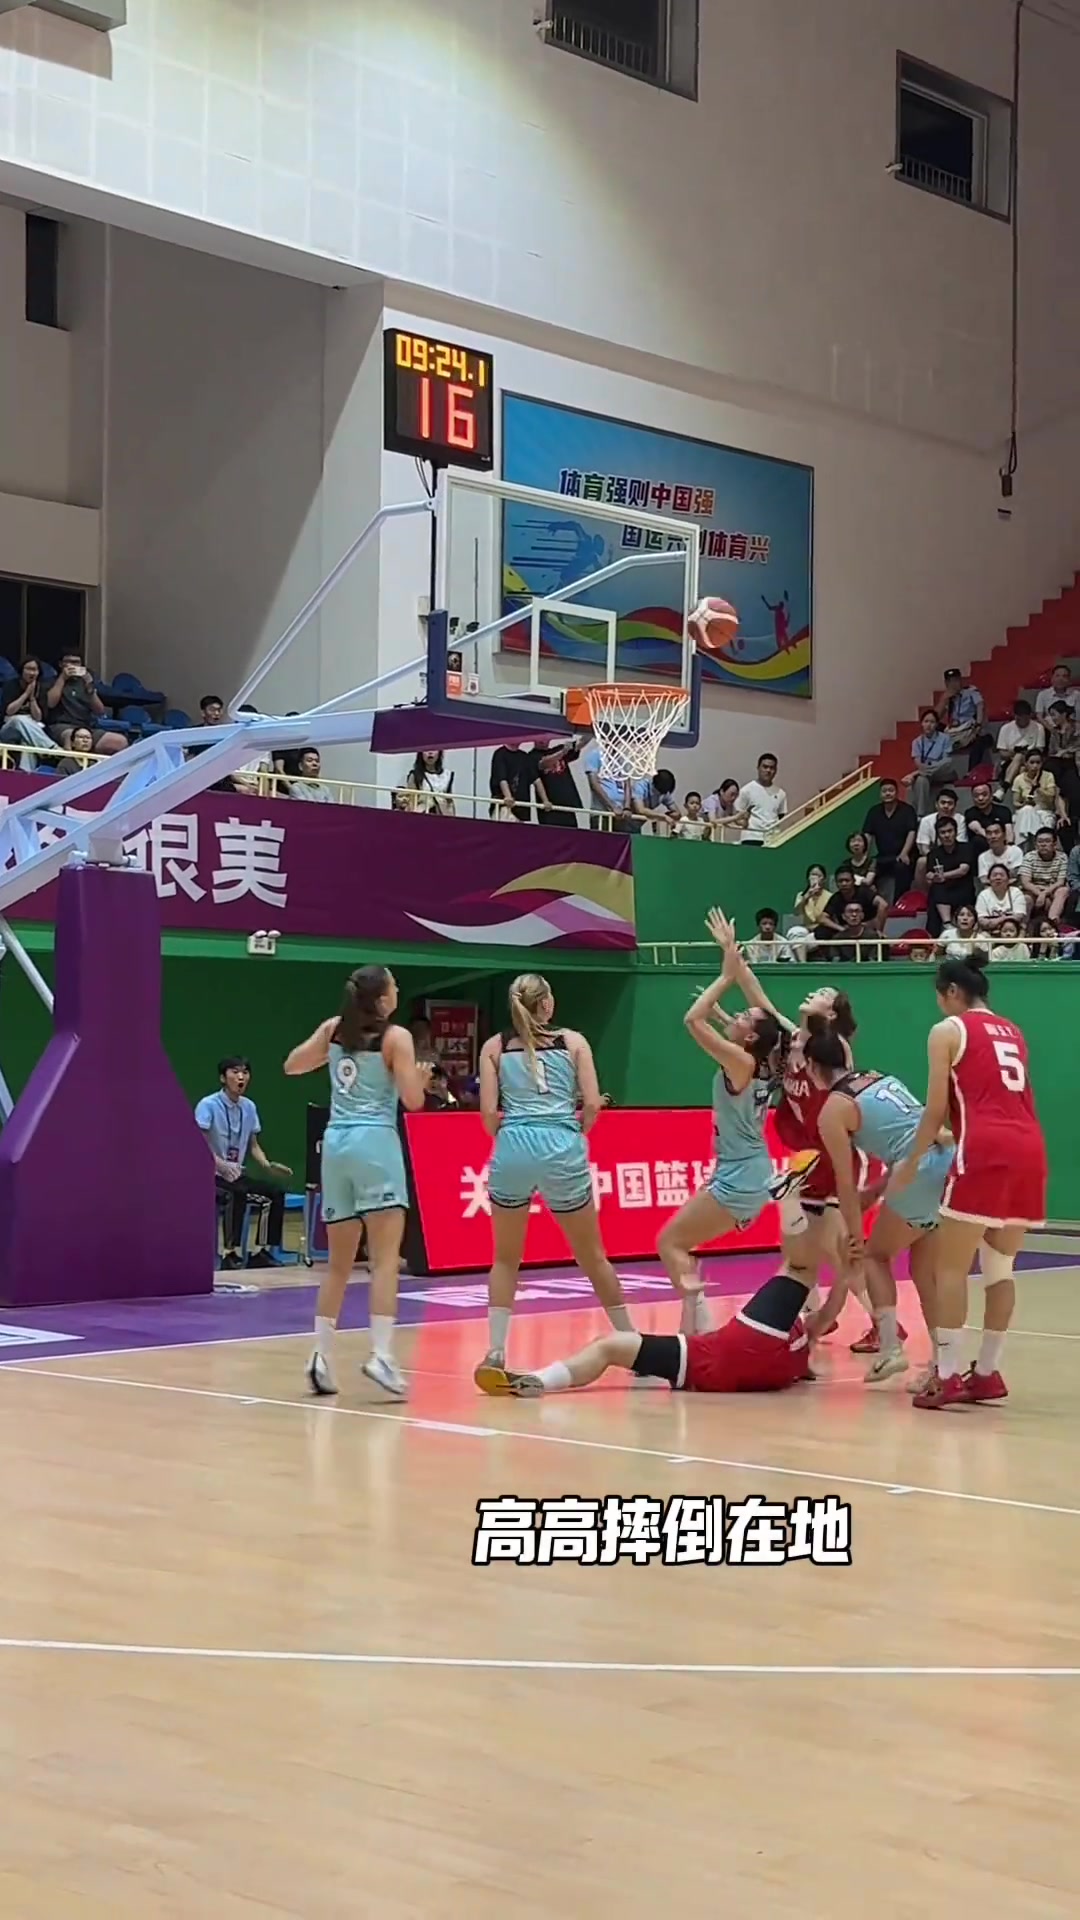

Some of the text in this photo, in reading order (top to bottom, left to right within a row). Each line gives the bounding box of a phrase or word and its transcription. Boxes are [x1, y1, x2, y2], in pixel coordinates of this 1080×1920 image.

[396, 333, 485, 387] 09:24.1
[421, 377, 474, 449] 16
[560, 469, 715, 517] 体育强则中国强
[621, 524, 771, 563] 国运体育兴
[336, 1056, 359, 1094] 9
[993, 1040, 1025, 1092] 5
